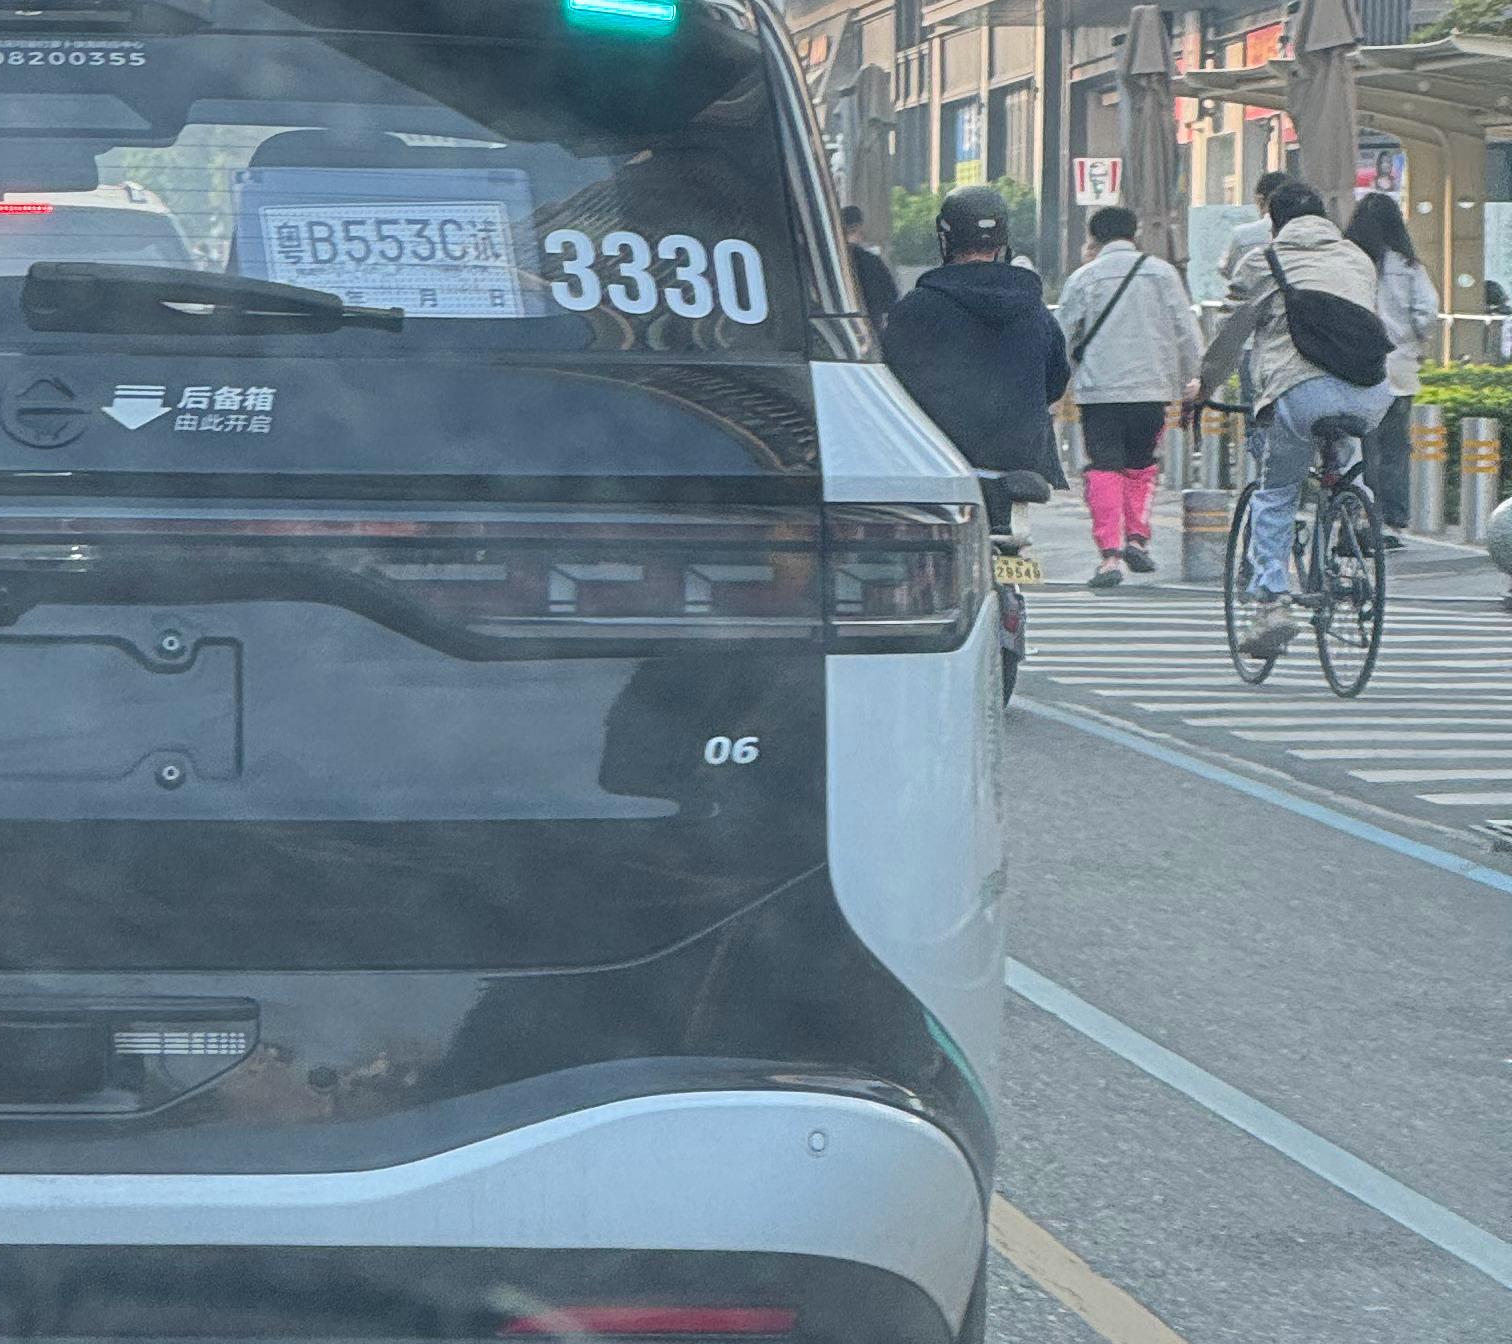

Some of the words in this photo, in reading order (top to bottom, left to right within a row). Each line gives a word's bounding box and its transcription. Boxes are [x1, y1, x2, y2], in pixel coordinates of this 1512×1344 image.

[544, 228, 769, 325] 3330
[176, 386, 277, 411] 后备箱
[174, 414, 273, 433] 由此开启
[704, 736, 761, 765] 06
